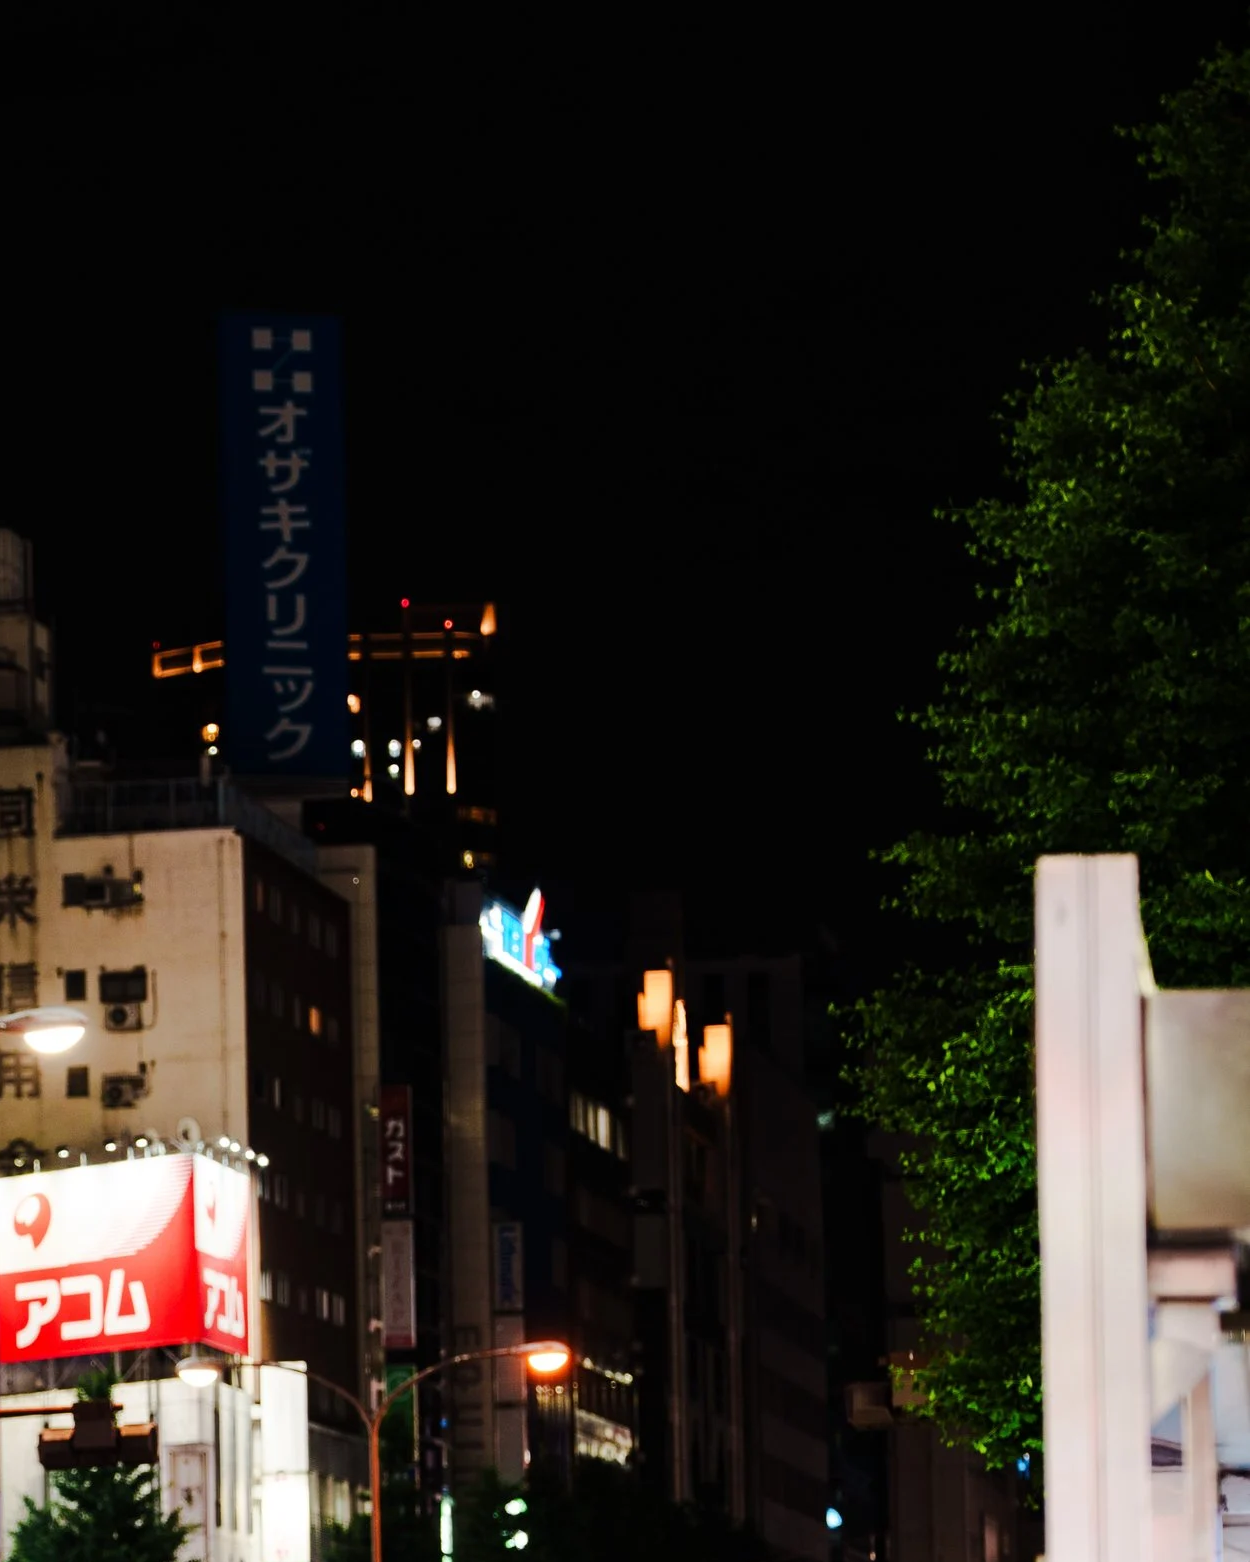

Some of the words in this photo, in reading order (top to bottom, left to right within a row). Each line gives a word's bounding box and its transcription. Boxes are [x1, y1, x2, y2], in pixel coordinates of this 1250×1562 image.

[257, 399, 314, 762] オザキクリニック
[384, 1117, 405, 1187] ガスト
[14, 1268, 151, 1349] アコム
[203, 1268, 247, 1339] アコム
